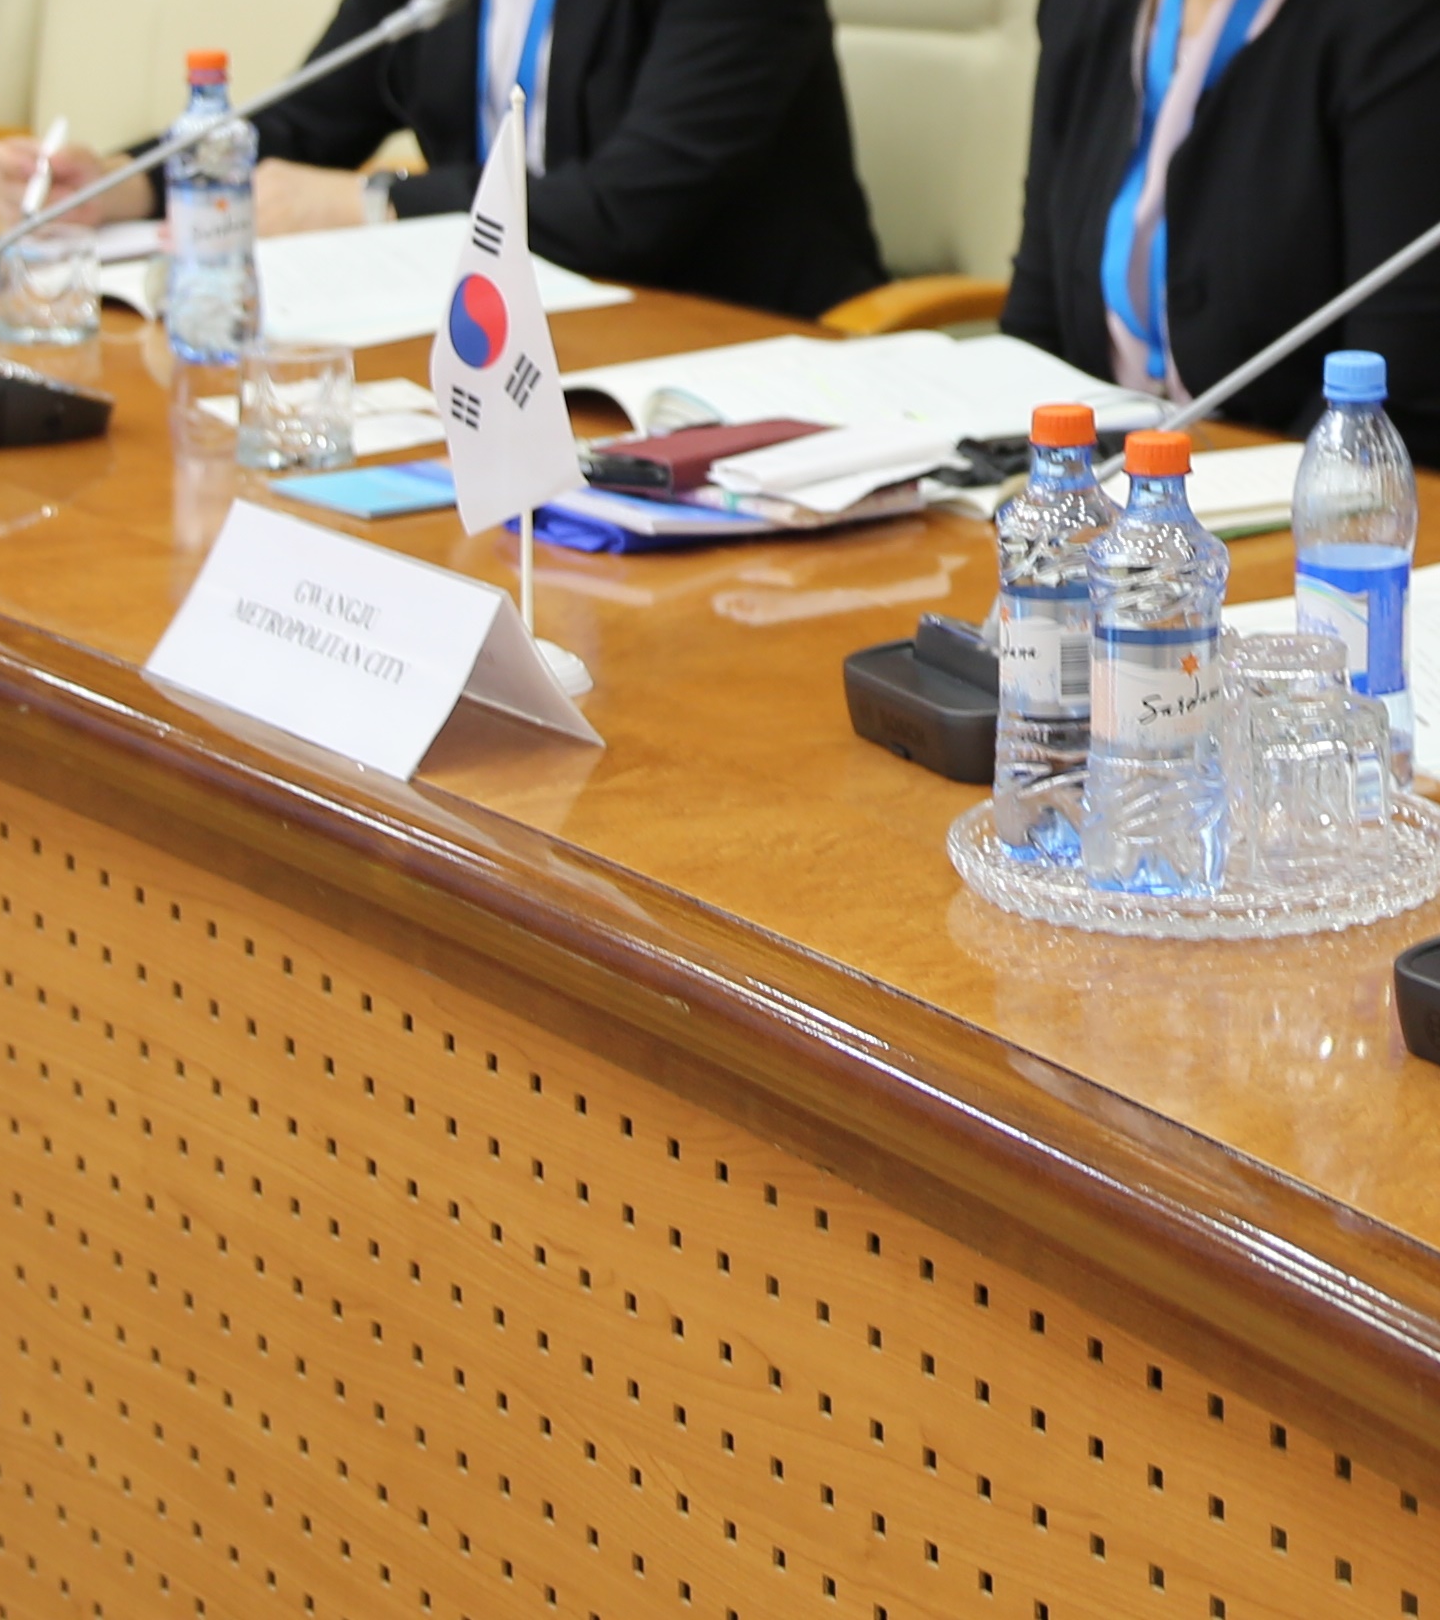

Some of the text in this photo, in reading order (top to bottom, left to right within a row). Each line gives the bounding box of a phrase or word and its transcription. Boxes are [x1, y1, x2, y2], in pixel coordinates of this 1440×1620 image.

[293, 579, 382, 631] GWANGJU
[232, 597, 411, 686] METROPOLITAN CITY
